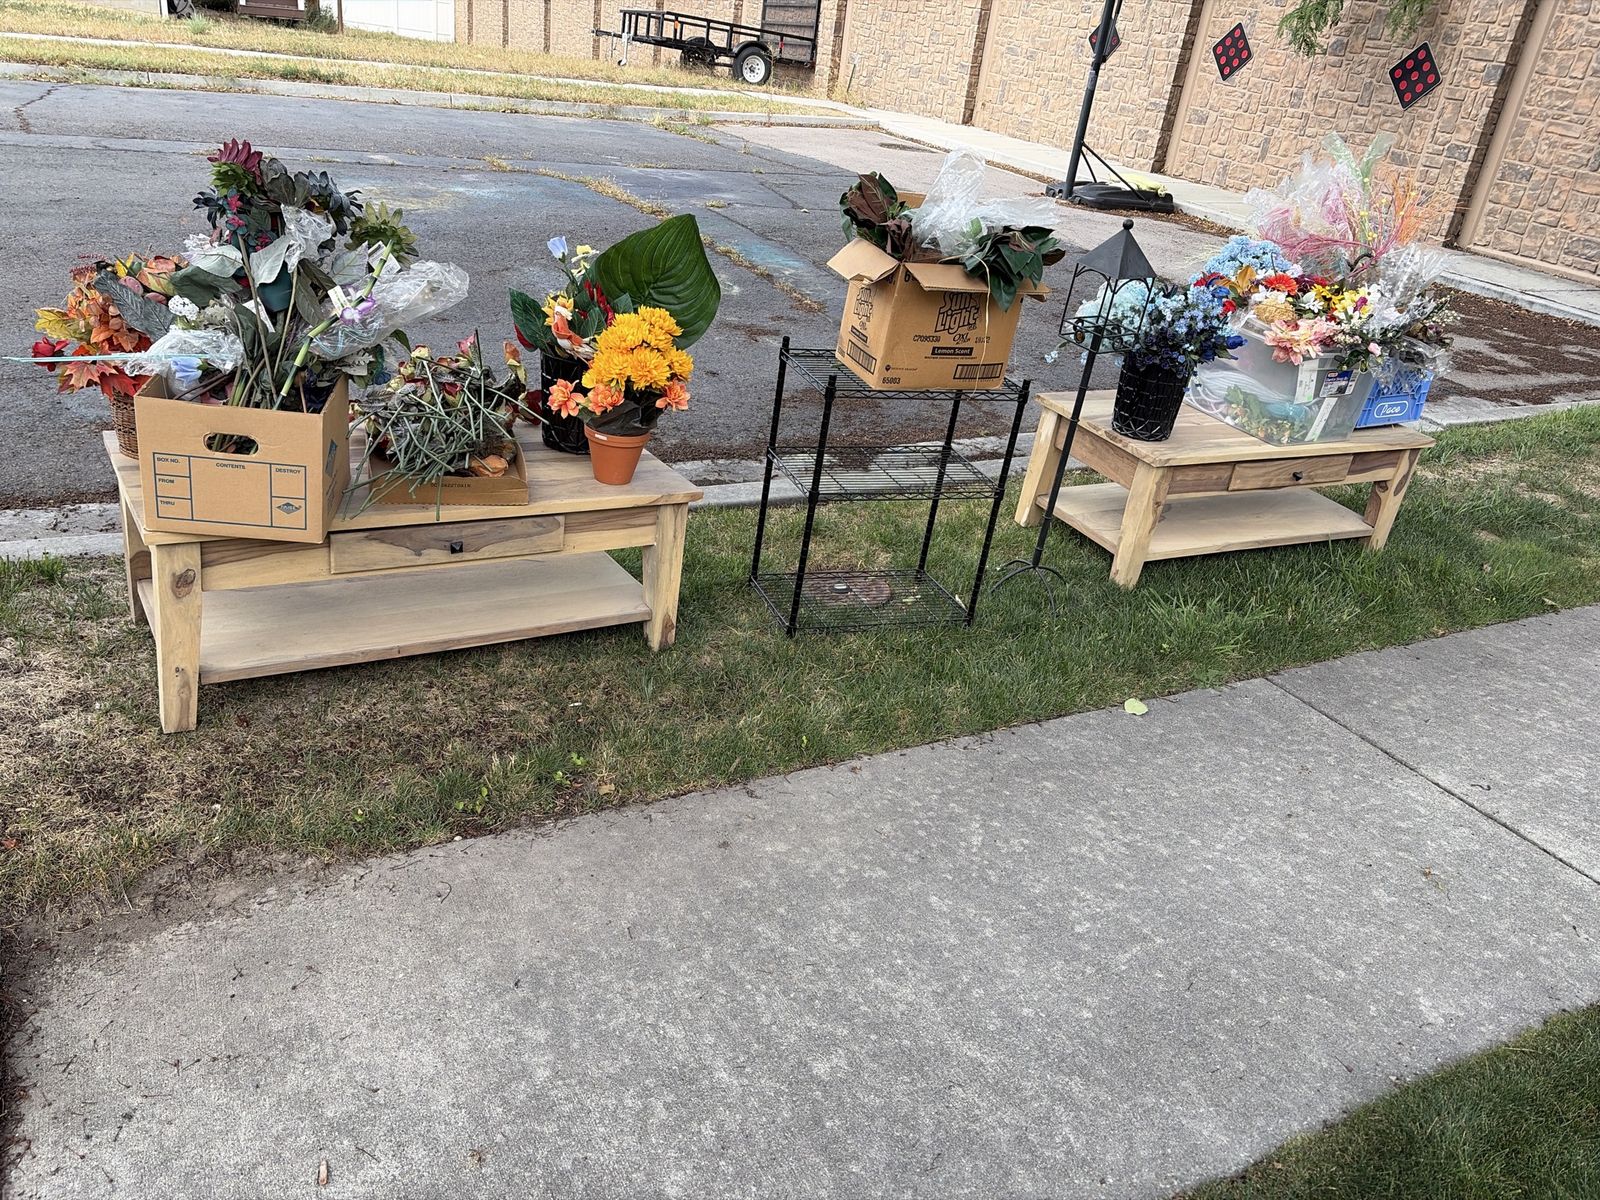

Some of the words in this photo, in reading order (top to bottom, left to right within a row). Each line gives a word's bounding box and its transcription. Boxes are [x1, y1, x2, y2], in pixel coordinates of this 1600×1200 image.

[934, 306, 980, 335] Light
[215, 462, 246, 470] CONTENTS
[275, 467, 301, 475] DESTROY
